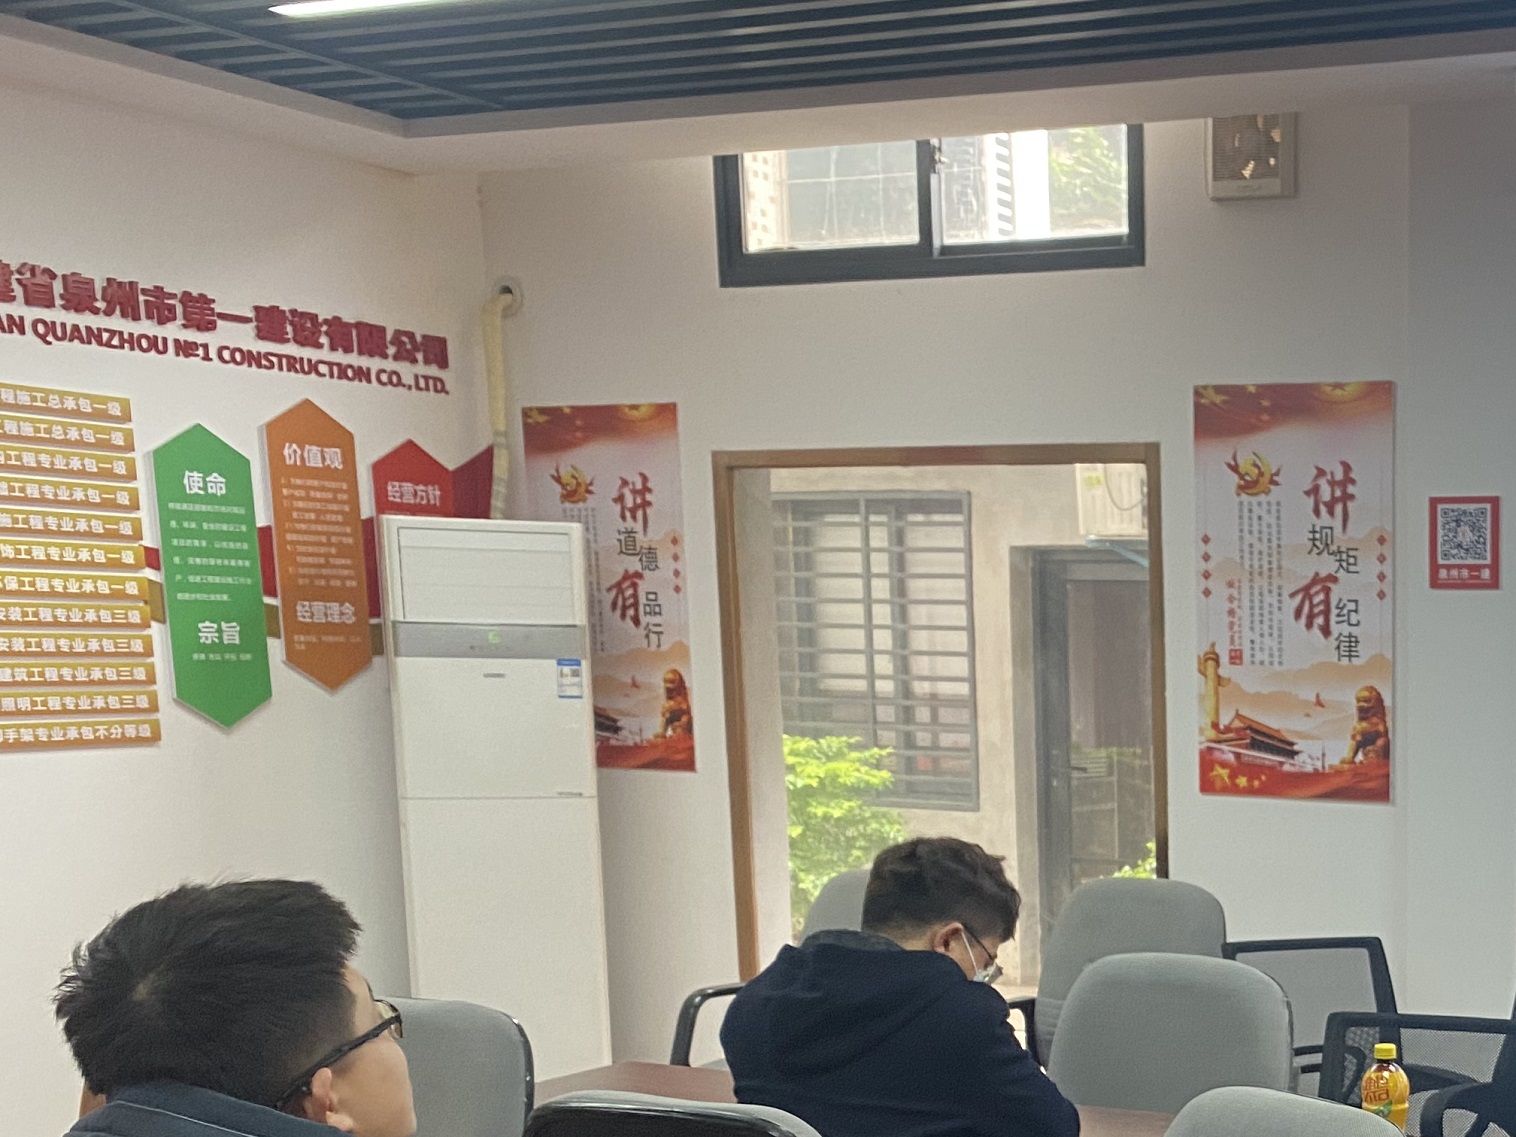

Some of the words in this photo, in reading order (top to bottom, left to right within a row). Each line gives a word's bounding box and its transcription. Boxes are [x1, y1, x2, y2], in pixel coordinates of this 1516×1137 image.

[31, 318, 168, 354] QUANZHOU
[217, 345, 371, 384] CONSTRUCTION
[0, 419, 125, 447] 程施工总承包一级
[282, 442, 343, 470] 价值观
[183, 469, 226, 497] 使命
[386, 481, 441, 507] 经营方针
[0, 574, 139, 596] 保工程专业承包一级
[296, 600, 356, 625] 经营理念
[197, 621, 241, 646] 宗旨
[0, 723, 151, 743] 手架专业承包不分等级
